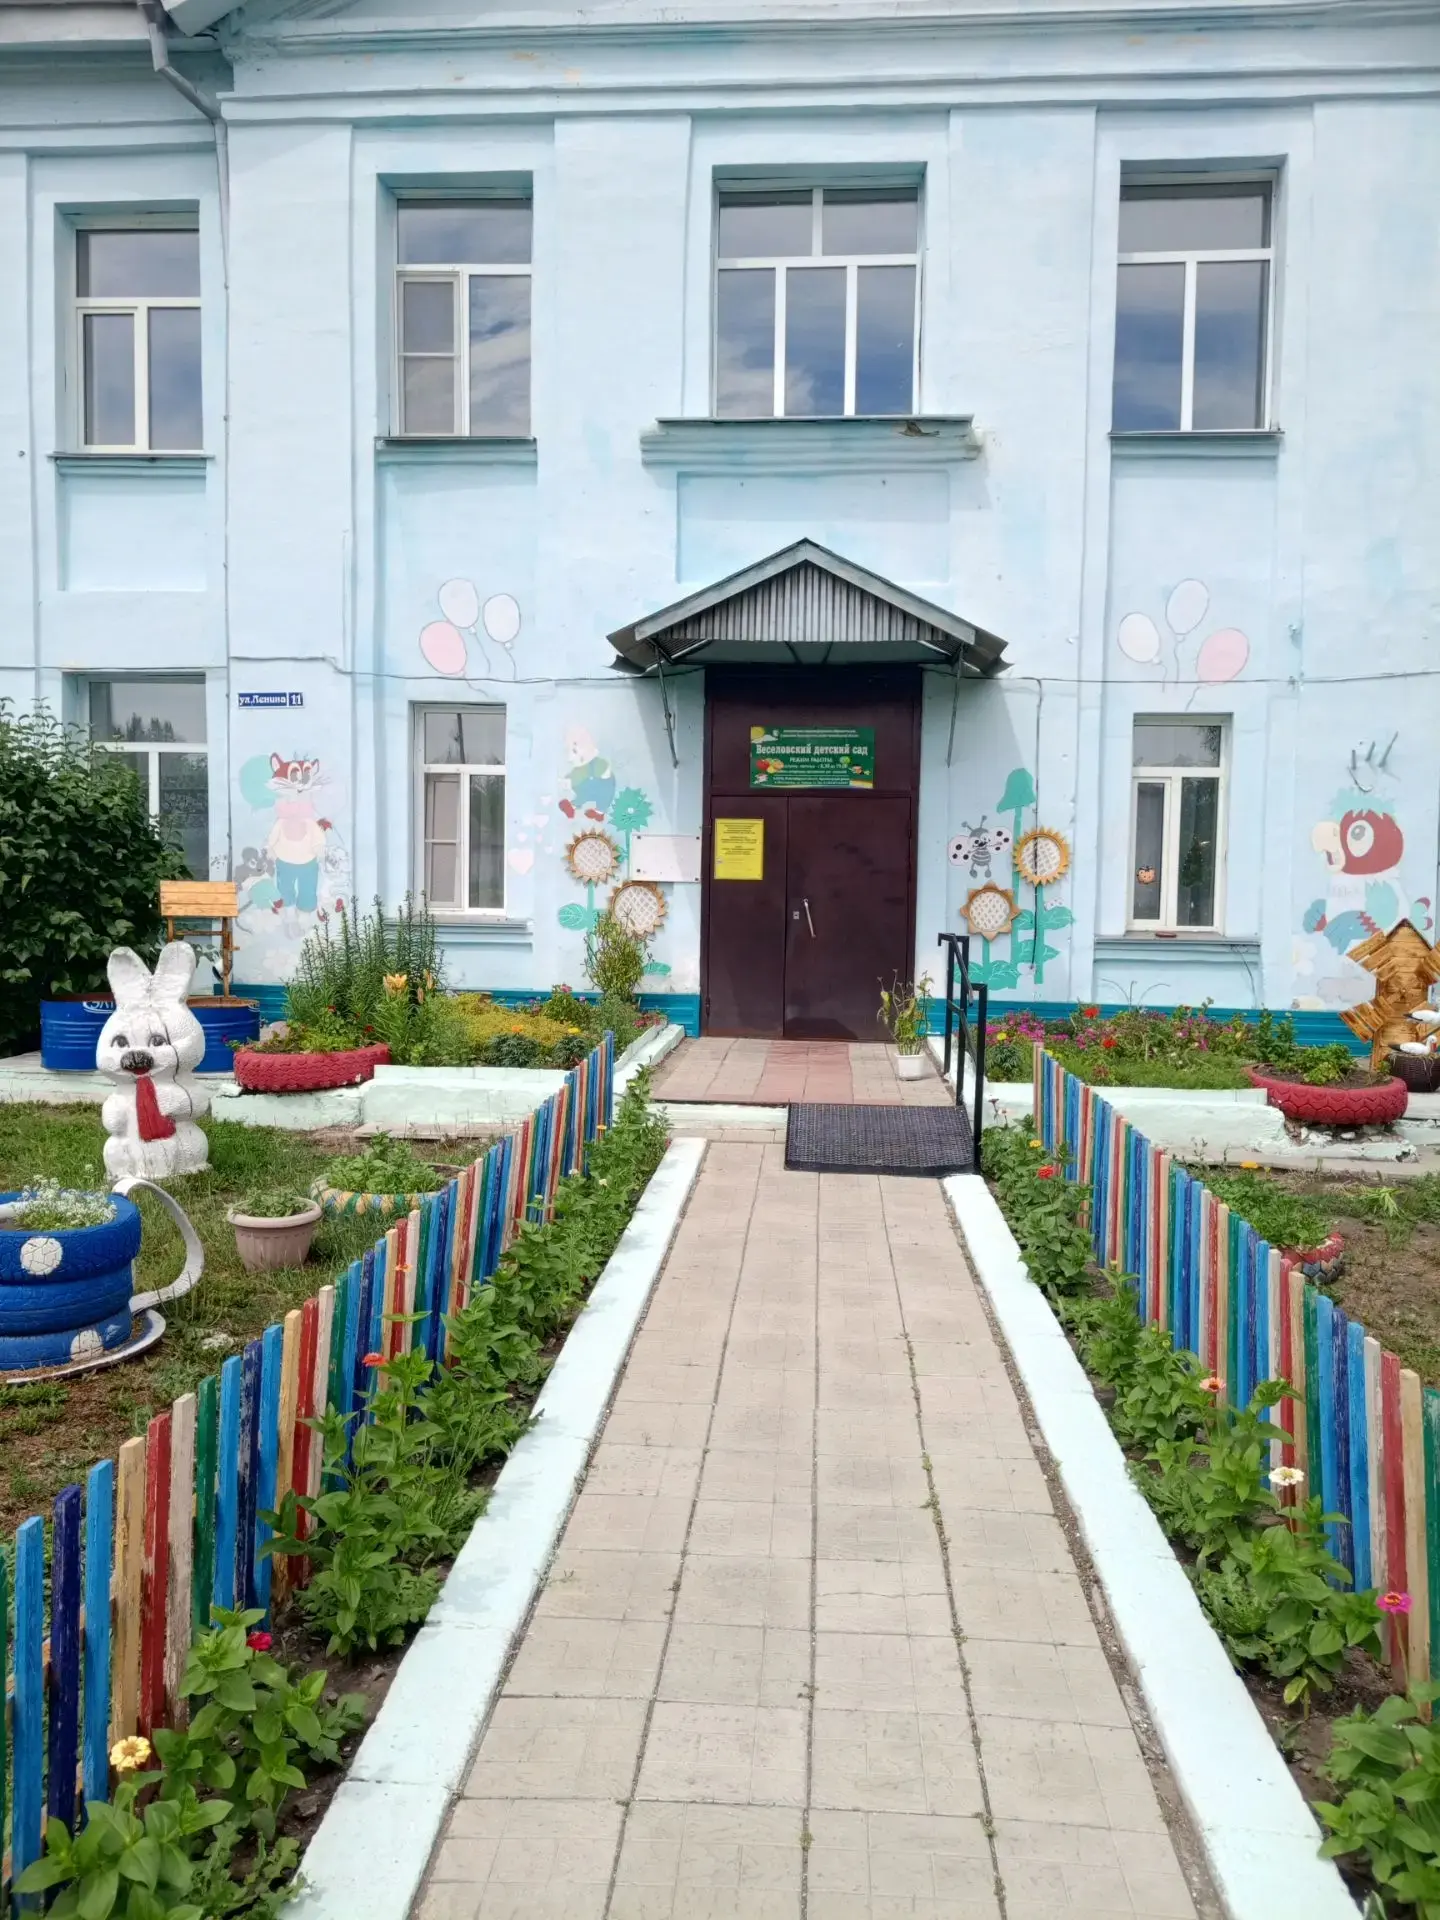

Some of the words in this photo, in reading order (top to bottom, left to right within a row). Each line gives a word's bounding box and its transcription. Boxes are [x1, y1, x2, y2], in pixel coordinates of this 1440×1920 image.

[291, 694, 302, 705] 11
[756, 743, 812, 755] Веселовский
[813, 743, 850, 756] детский
[852, 746, 869, 756] сад
